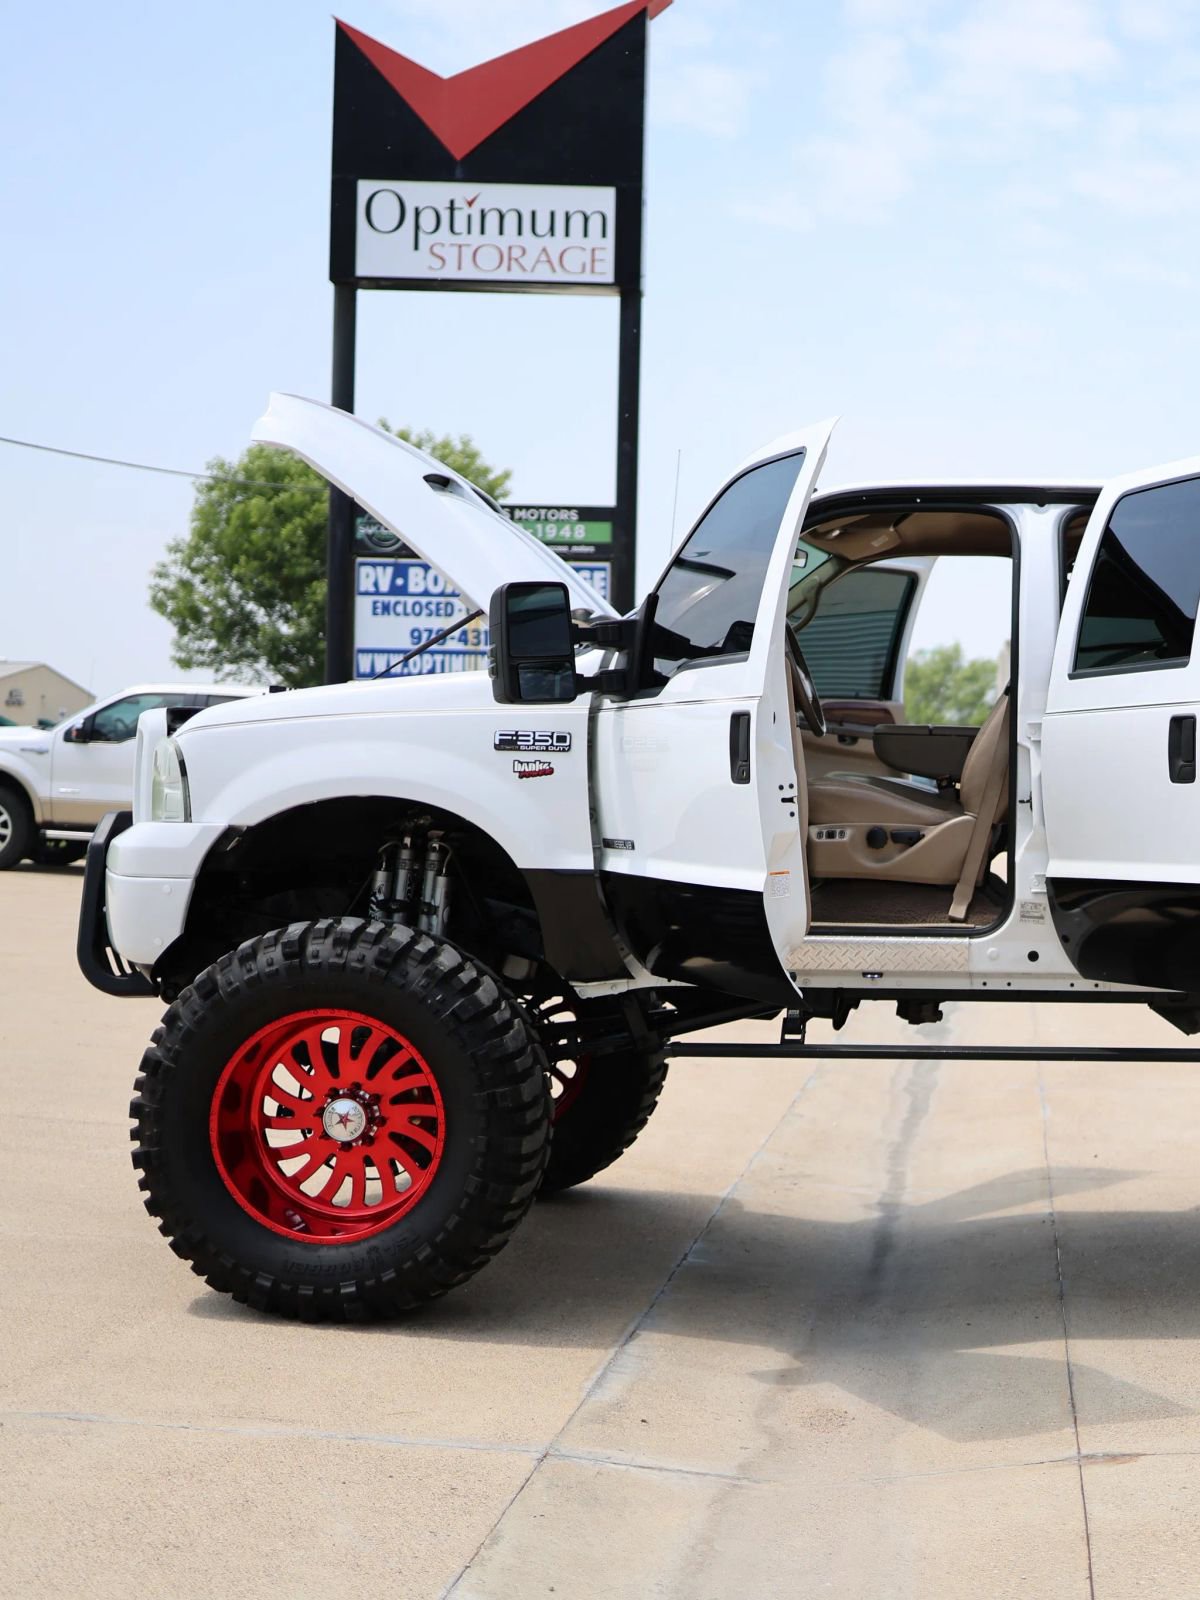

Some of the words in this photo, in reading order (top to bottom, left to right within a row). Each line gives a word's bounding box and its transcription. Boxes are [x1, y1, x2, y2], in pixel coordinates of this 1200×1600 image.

[365, 189, 608, 251] Optimum
[428, 243, 608, 275] STORAGE
[514, 508, 579, 520] MOTORS
[359, 565, 394, 592] RV
[372, 600, 454, 617] ENCLOSED
